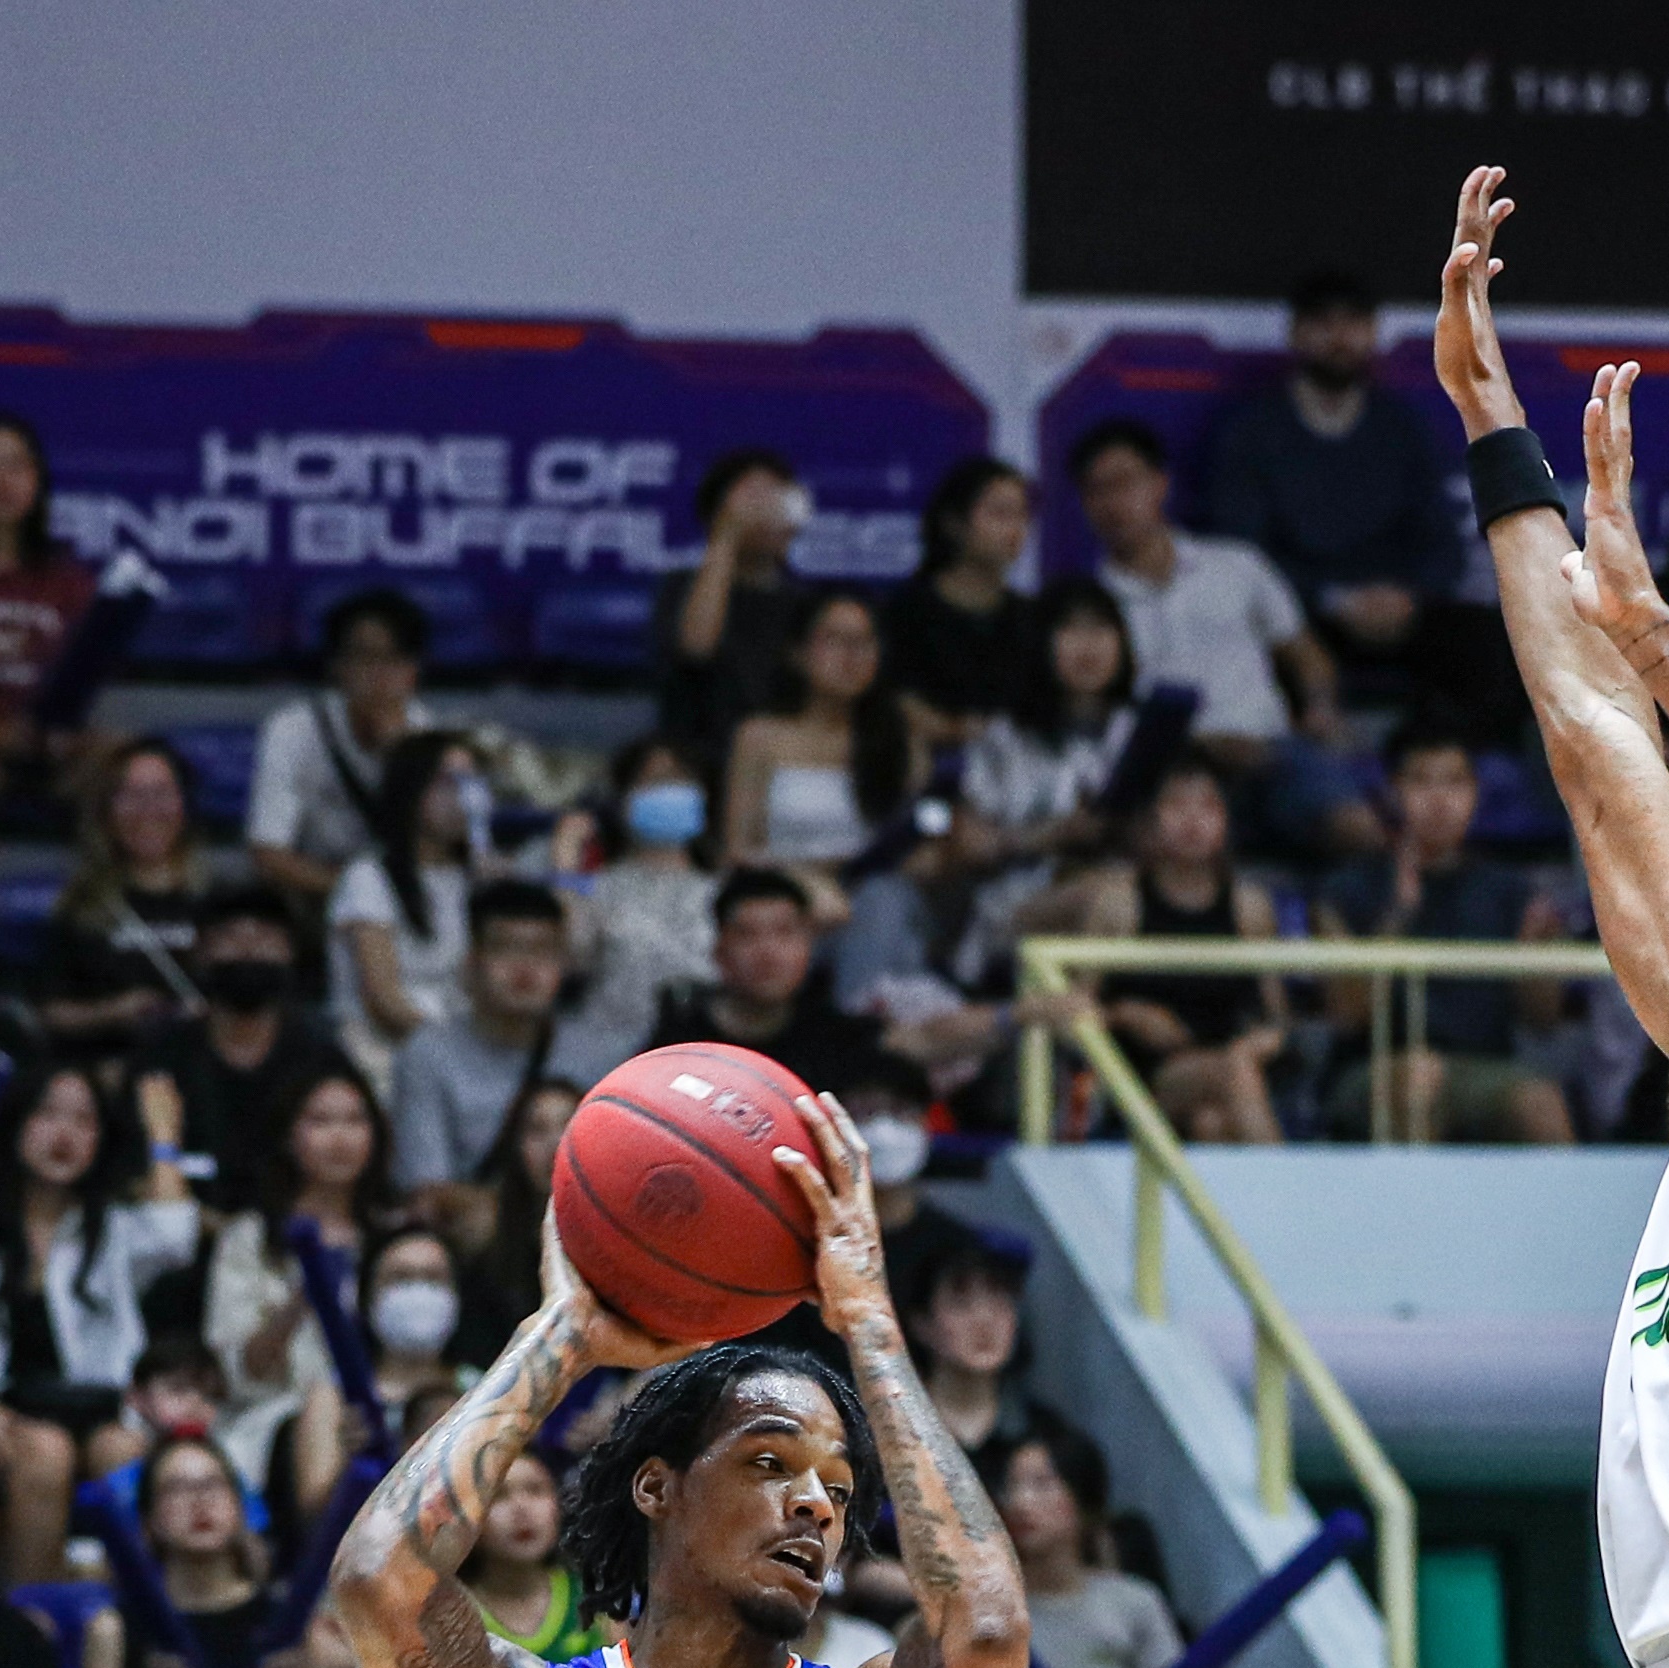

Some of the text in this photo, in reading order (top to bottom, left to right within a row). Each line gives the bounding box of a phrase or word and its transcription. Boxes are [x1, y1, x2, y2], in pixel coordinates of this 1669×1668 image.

[201, 431, 677, 504] HOME OF
[49, 491, 927, 578] ANOI BUFFALES
